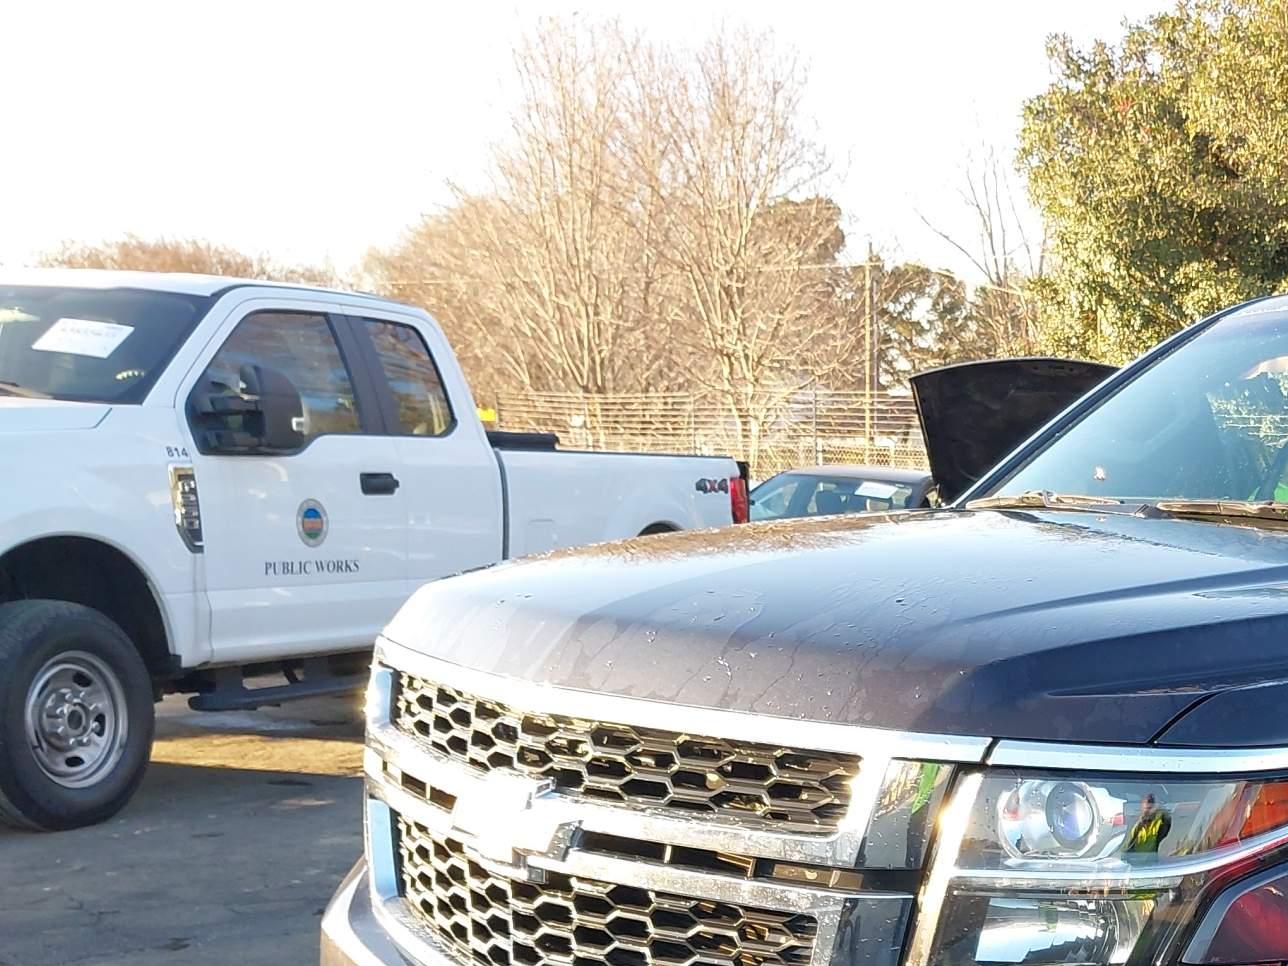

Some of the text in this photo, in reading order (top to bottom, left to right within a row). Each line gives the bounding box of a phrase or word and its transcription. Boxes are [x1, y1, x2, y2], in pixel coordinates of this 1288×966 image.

[166, 446, 188, 458] 814
[264, 558, 360, 576] PUBLIC WORKS
